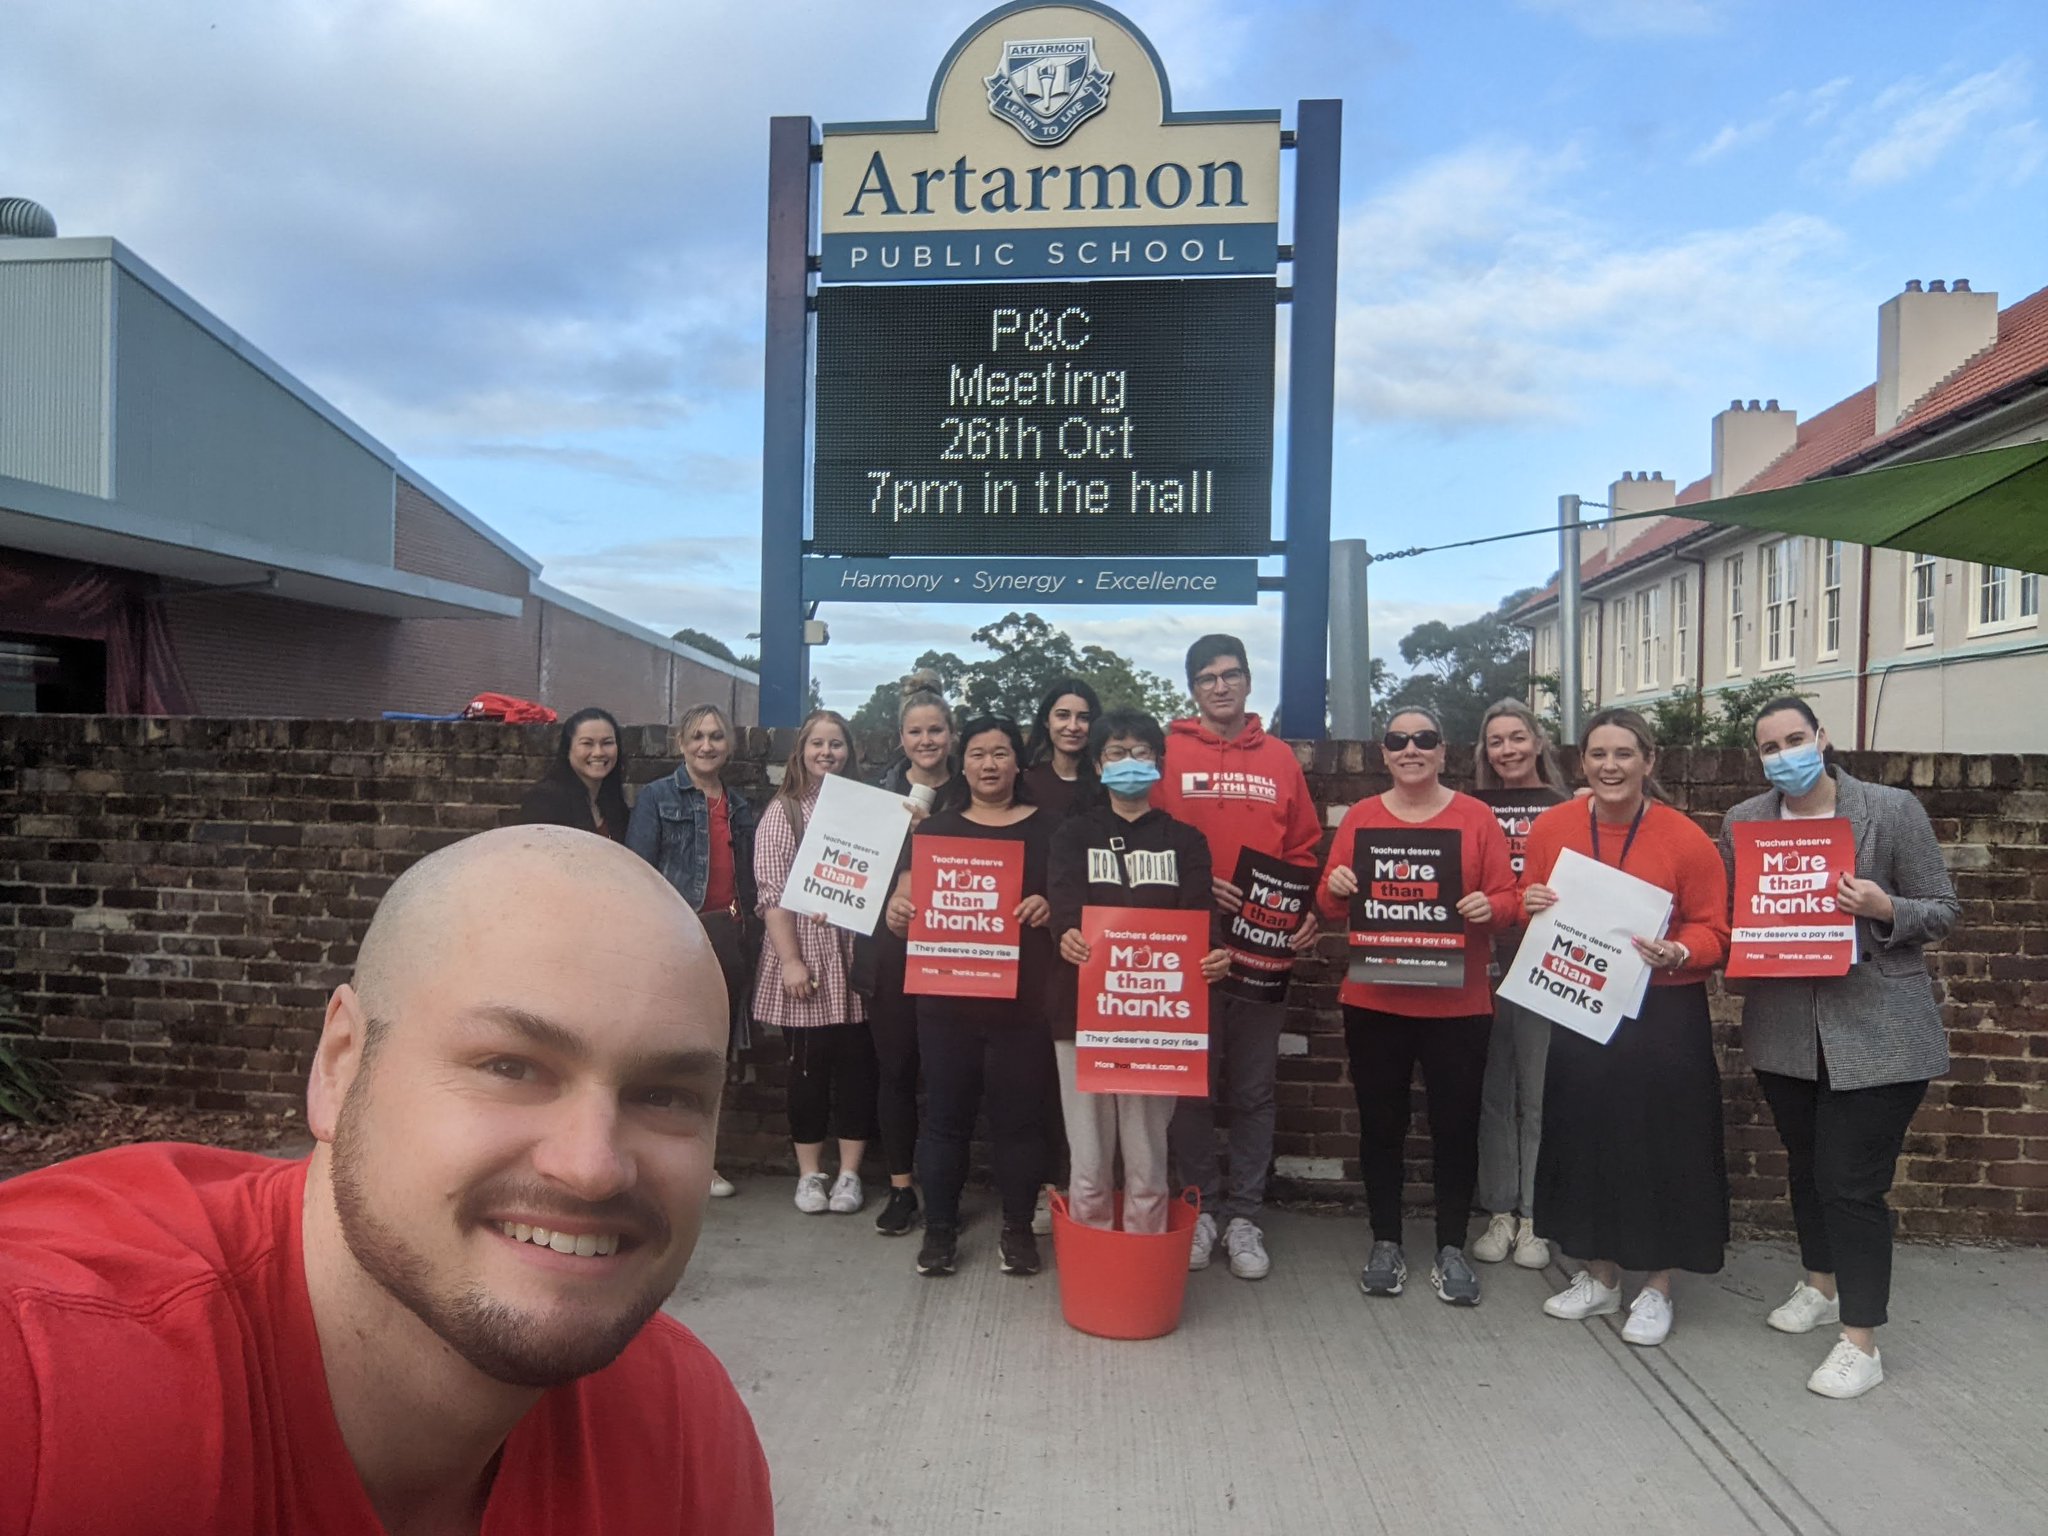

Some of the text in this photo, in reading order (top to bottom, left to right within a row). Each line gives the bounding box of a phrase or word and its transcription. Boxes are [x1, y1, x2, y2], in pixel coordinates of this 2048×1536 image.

[1011, 44, 1085, 55] ARTARMON
[1004, 101, 1085, 135] LEARN TO LIVE
[842, 150, 1251, 217] Artarmon
[850, 239, 1237, 269] PUBLIC SCHOOL
[992, 307, 1090, 351] P&C
[950, 362, 1126, 413] Meeting
[940, 416, 1135, 460] 26th Oct
[867, 470, 1213, 522] 7pm in the hall
[840, 570, 1218, 593] Harmony Synergy Excellence
[1212, 772, 1277, 788] RUSSELL
[1212, 782, 1276, 797] ATHLETIC
[1370, 846, 1441, 856] Teachers deserve
[1755, 837, 1832, 848] Teachers deserve
[821, 846, 869, 873] More
[932, 855, 1004, 867] Teachers deserve
[1375, 859, 1435, 880] More
[1763, 851, 1826, 872] More
[821, 866, 855, 886] than
[936, 868, 997, 891] More
[1251, 868, 1282, 886] Teachers
[1769, 876, 1813, 891] than
[803, 876, 866, 910] thanks
[941, 892, 984, 908] than
[1249, 882, 1301, 912] More
[1380, 883, 1424, 897] than
[1364, 899, 1447, 921] thanks
[1751, 893, 1836, 915] thanks
[924, 909, 1005, 933] thanks
[1250, 908, 1287, 927] than
[1104, 929, 1188, 942] Teachers deserve
[1356, 934, 1378, 943] They
[1379, 935, 1413, 944] deserve
[1422, 937, 1440, 946] pay
[1441, 937, 1457, 945] rise
[1589, 936, 1622, 954] deserve
[1740, 930, 1761, 939] They
[1809, 931, 1826, 939] pay
[1828, 930, 1845, 938] rise
[915, 944, 936, 953] They
[937, 946, 970, 954] deserve
[978, 949, 995, 957] pay
[996, 949, 1011, 957] rise
[1110, 945, 1180, 970] More
[1551, 934, 1608, 972] More
[1116, 973, 1166, 990] than
[1550, 957, 1591, 985] than
[1528, 966, 1604, 1014] thanks
[1096, 992, 1190, 1018] thanks
[1085, 1034, 1110, 1044] They
[1112, 1035, 1150, 1045] deserve
[1161, 1039, 1179, 1047] pay
[1181, 1039, 1199, 1047] rise
